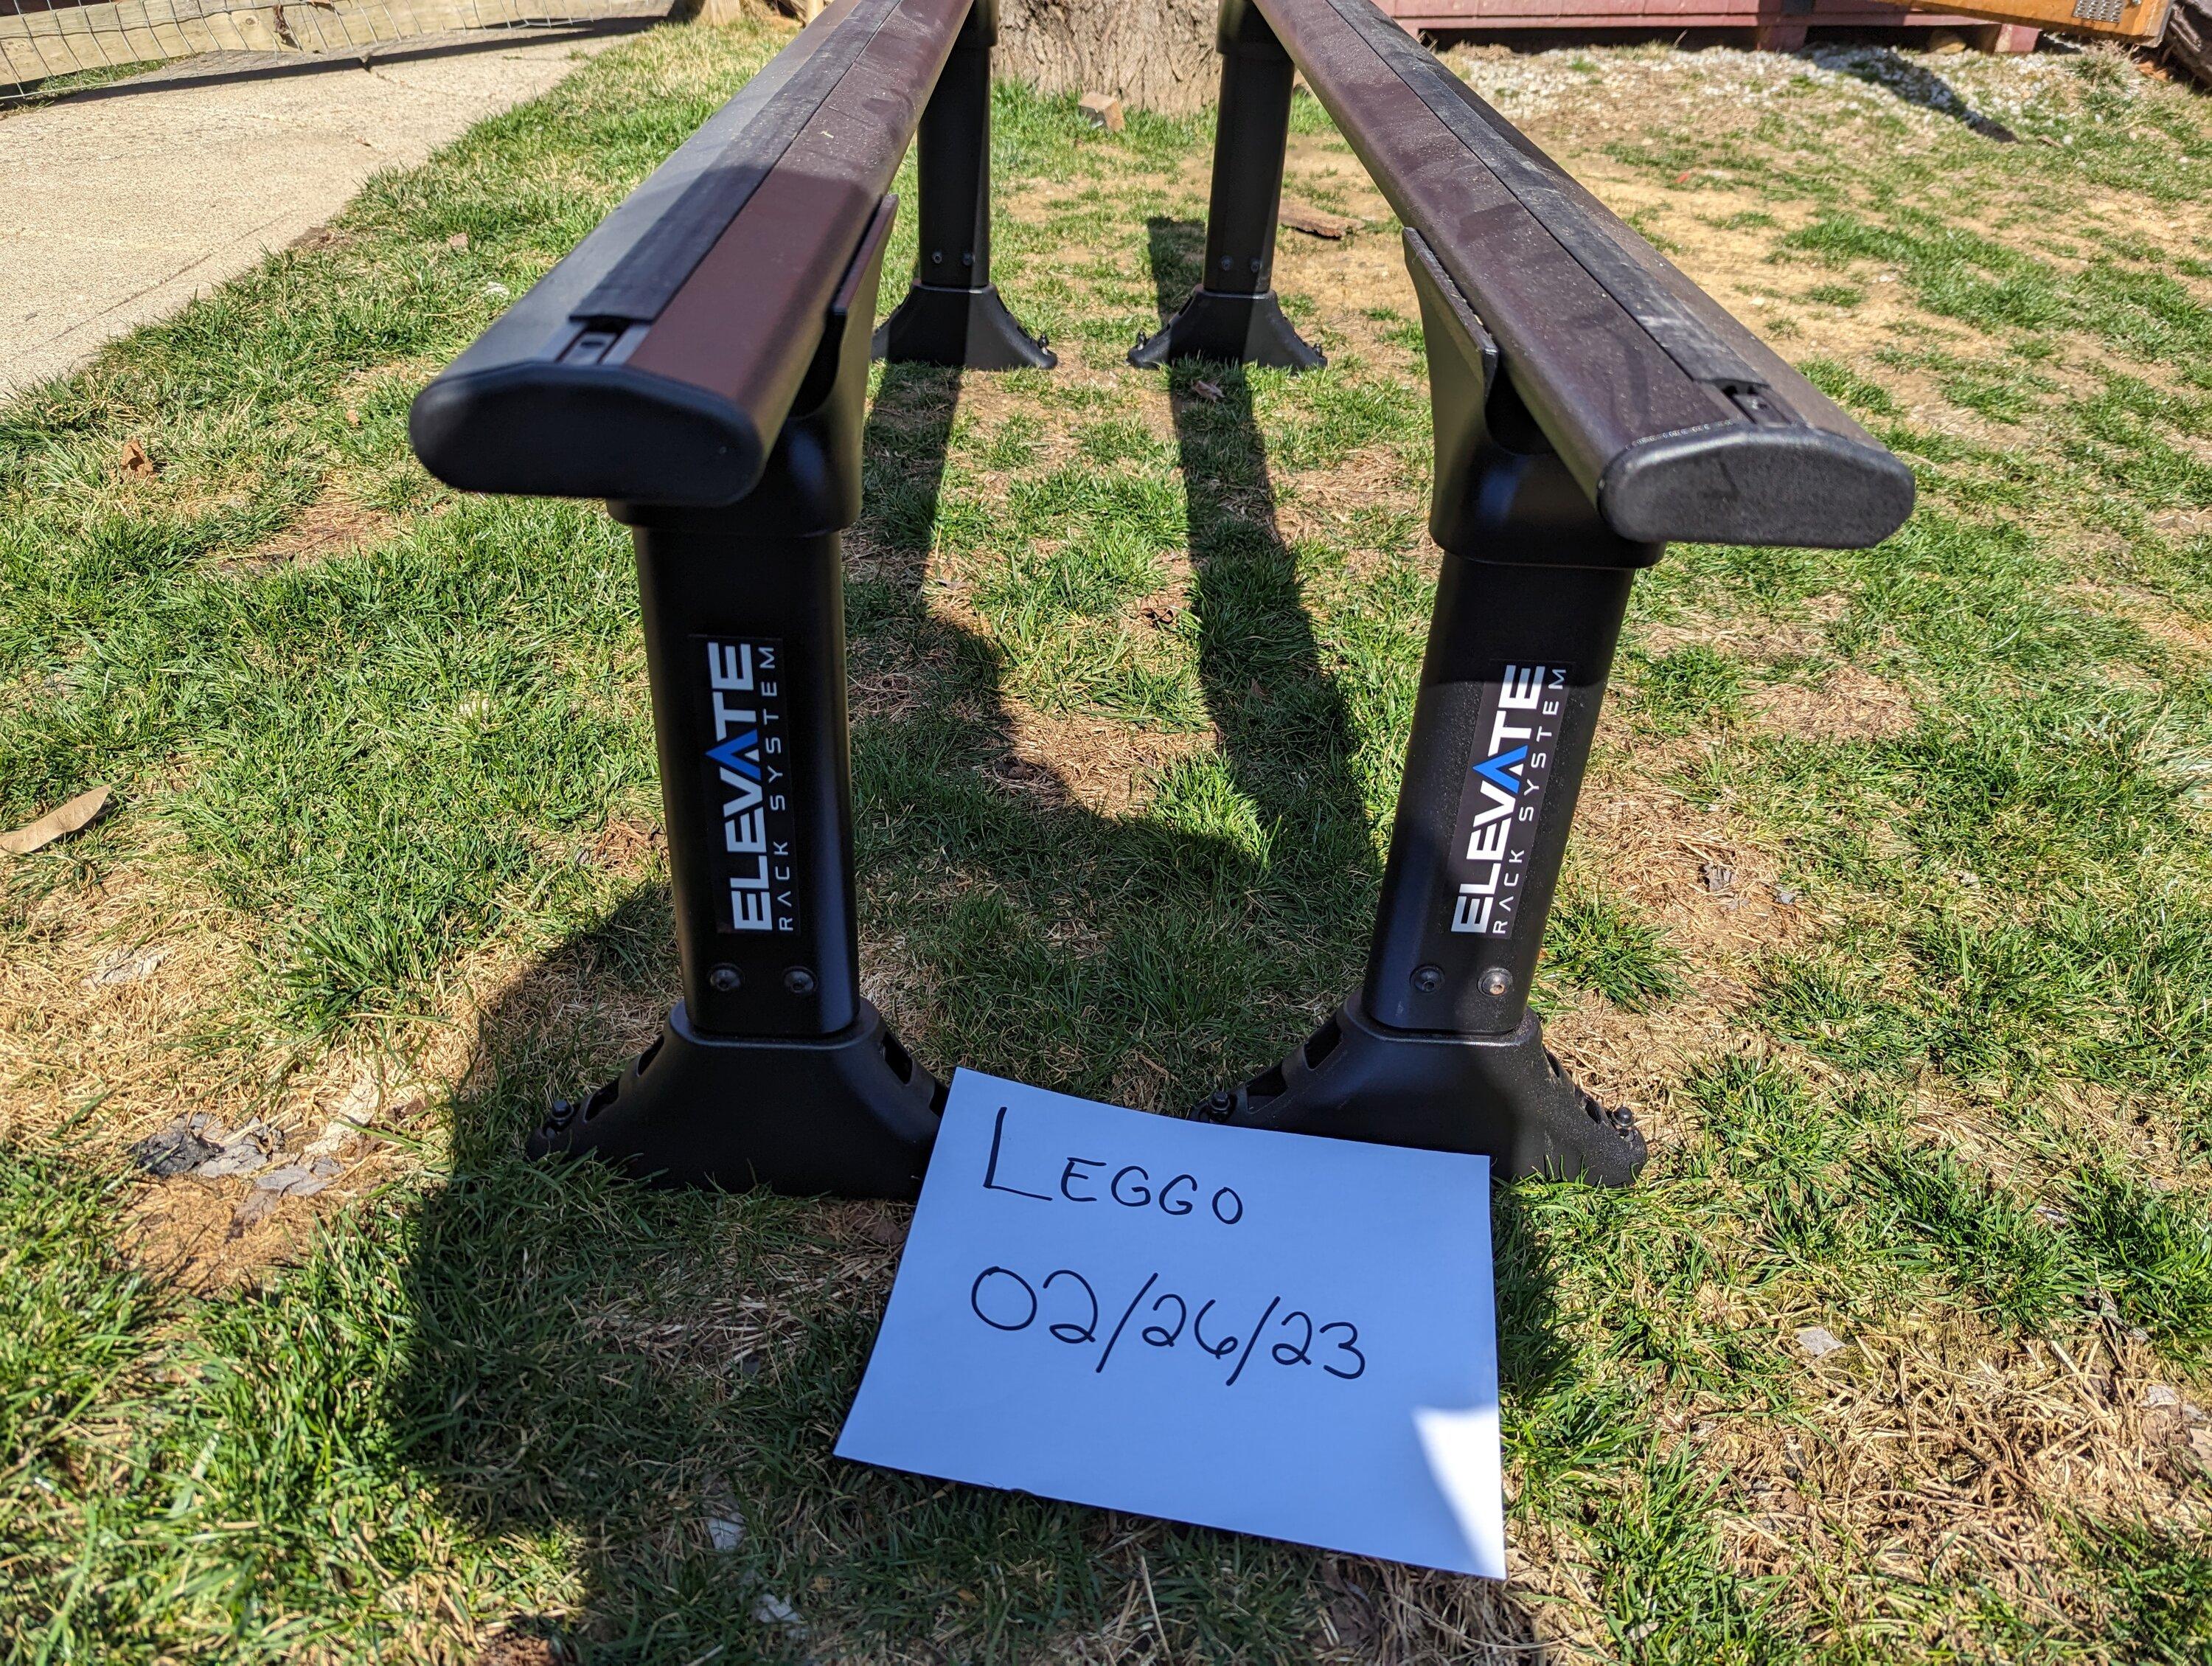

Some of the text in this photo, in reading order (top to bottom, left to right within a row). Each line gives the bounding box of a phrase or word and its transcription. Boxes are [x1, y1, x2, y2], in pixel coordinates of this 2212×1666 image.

[706, 642, 773, 931] ELEVATE
[759, 646, 794, 931] RACK SYSTEM
[1450, 664, 1545, 934] ELEVATE
[1492, 668, 1567, 934] RACK SYSTEM
[982, 1106, 1244, 1225] LEGGO
[971, 1266, 1366, 1386] 02/26/23
